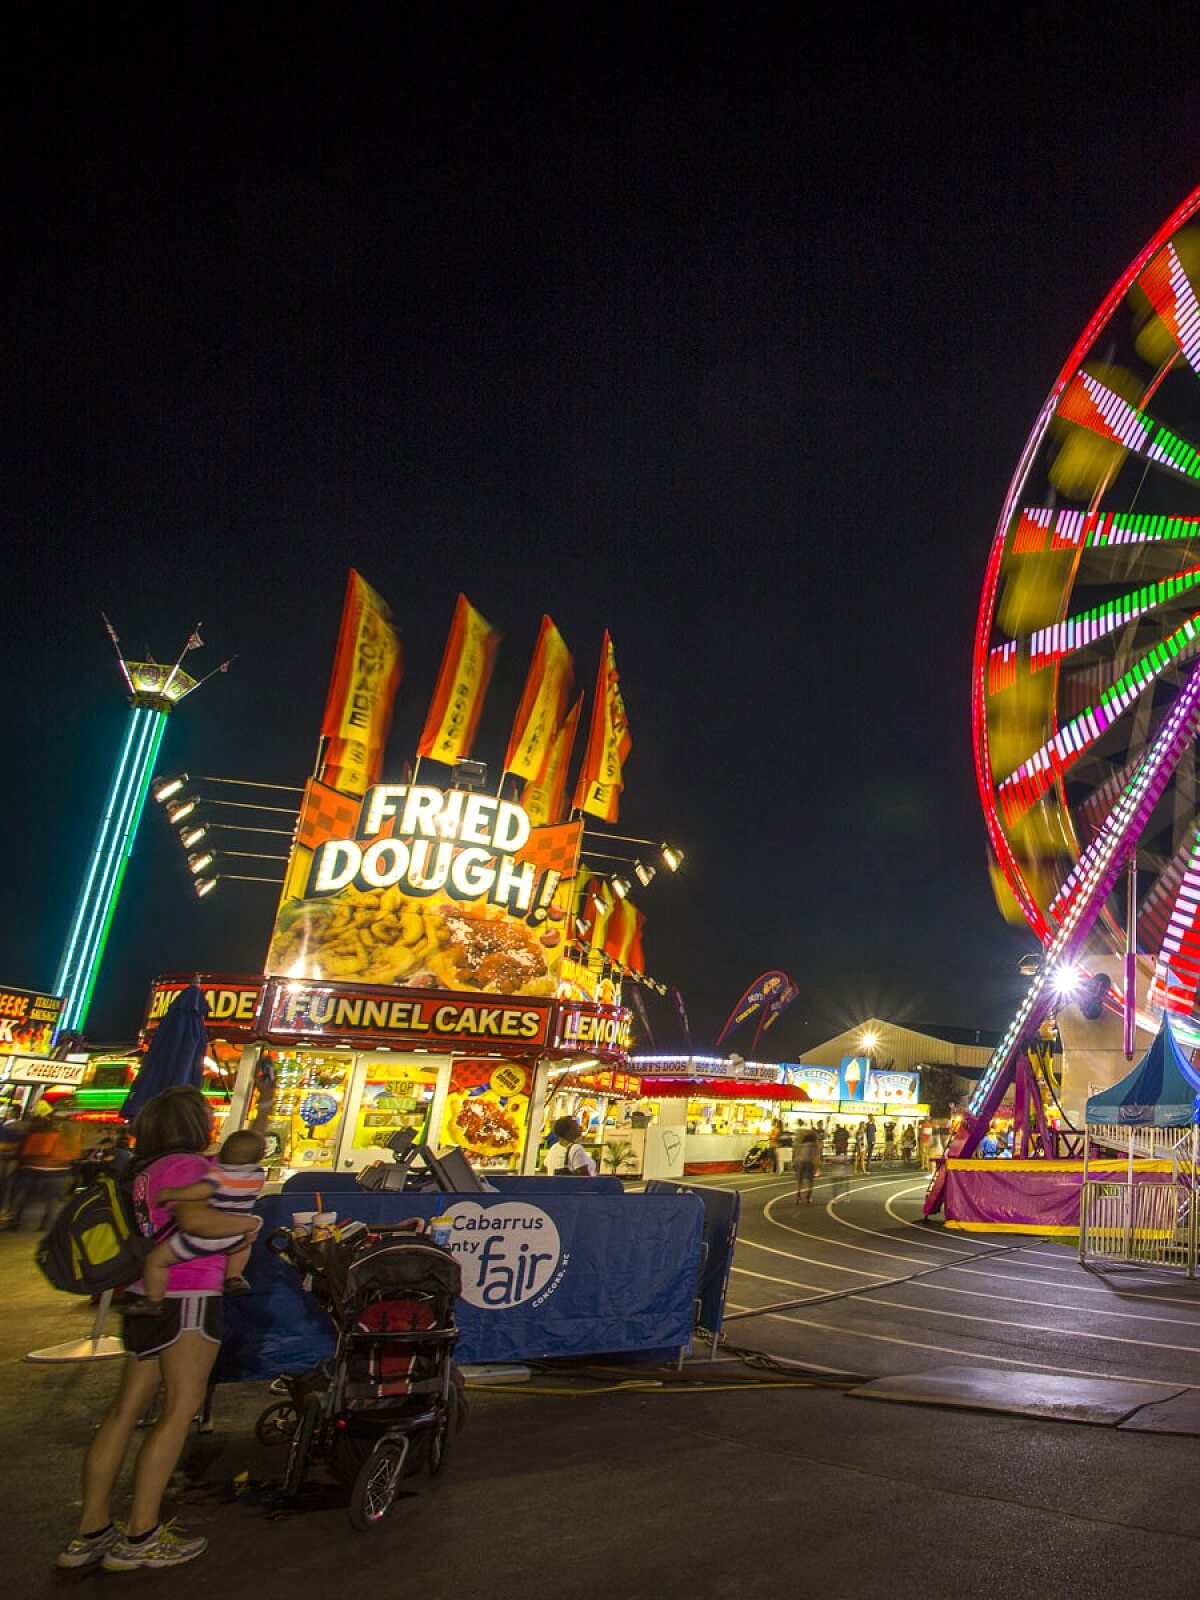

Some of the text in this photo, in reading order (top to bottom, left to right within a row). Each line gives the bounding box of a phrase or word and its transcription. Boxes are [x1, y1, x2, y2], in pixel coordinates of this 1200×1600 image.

[363, 785, 532, 854] FRIED
[314, 839, 561, 922] DOUGH!
[285, 995, 541, 1037] FUNNEL CAKES
[663, 1061, 686, 1072] DOGS
[386, 1081, 414, 1095] STOP
[368, 1114, 420, 1127] EAT
[453, 1215, 544, 1231] Cabarrus
[476, 1235, 553, 1306] fair
